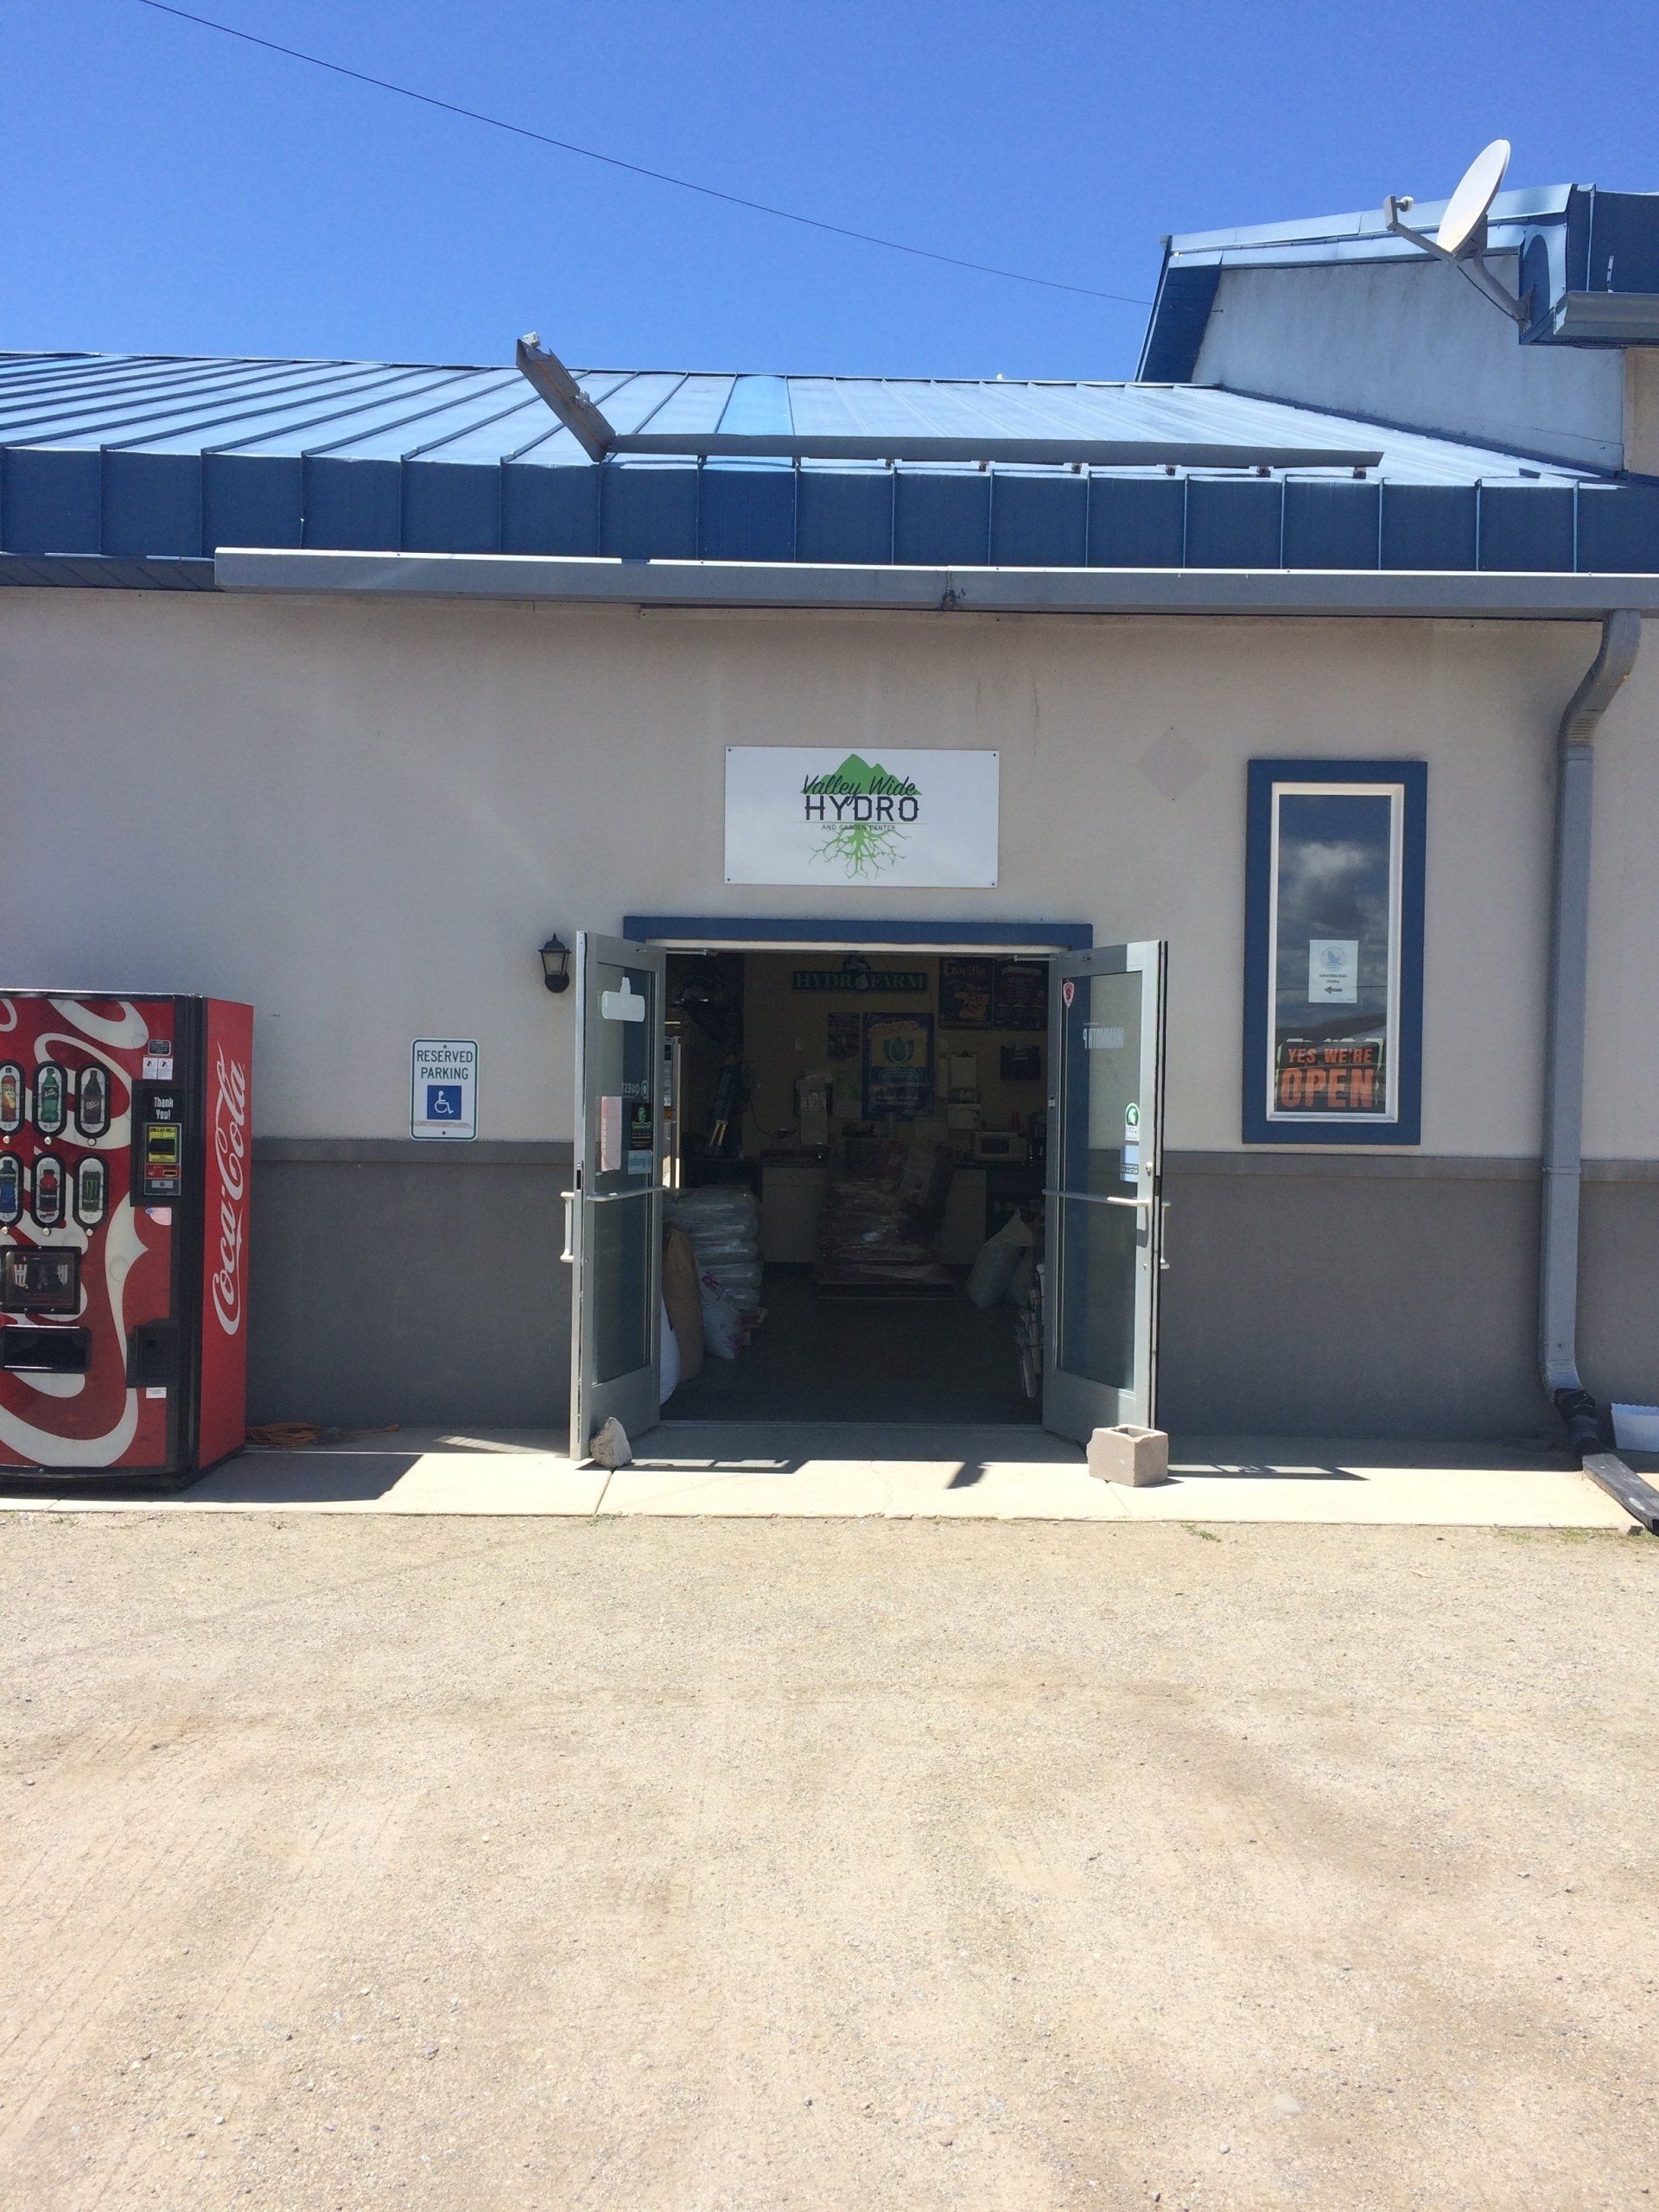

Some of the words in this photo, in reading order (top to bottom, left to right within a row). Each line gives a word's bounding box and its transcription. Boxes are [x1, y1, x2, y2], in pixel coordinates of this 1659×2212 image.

[803, 774, 861, 806] Valley
[868, 775, 918, 796] Wide
[804, 795, 919, 822] HYDRO
[416, 1050, 473, 1063] RESERVED
[1287, 1047, 1318, 1064] YES
[1324, 1048, 1373, 1065] WE'RE
[421, 1067, 468, 1080] PARKING
[1281, 1067, 1375, 1109] OPEN
[154, 1096, 174, 1109] Thank
[156, 1109, 170, 1121] You!
[213, 1040, 245, 1336] Coca-Cola
